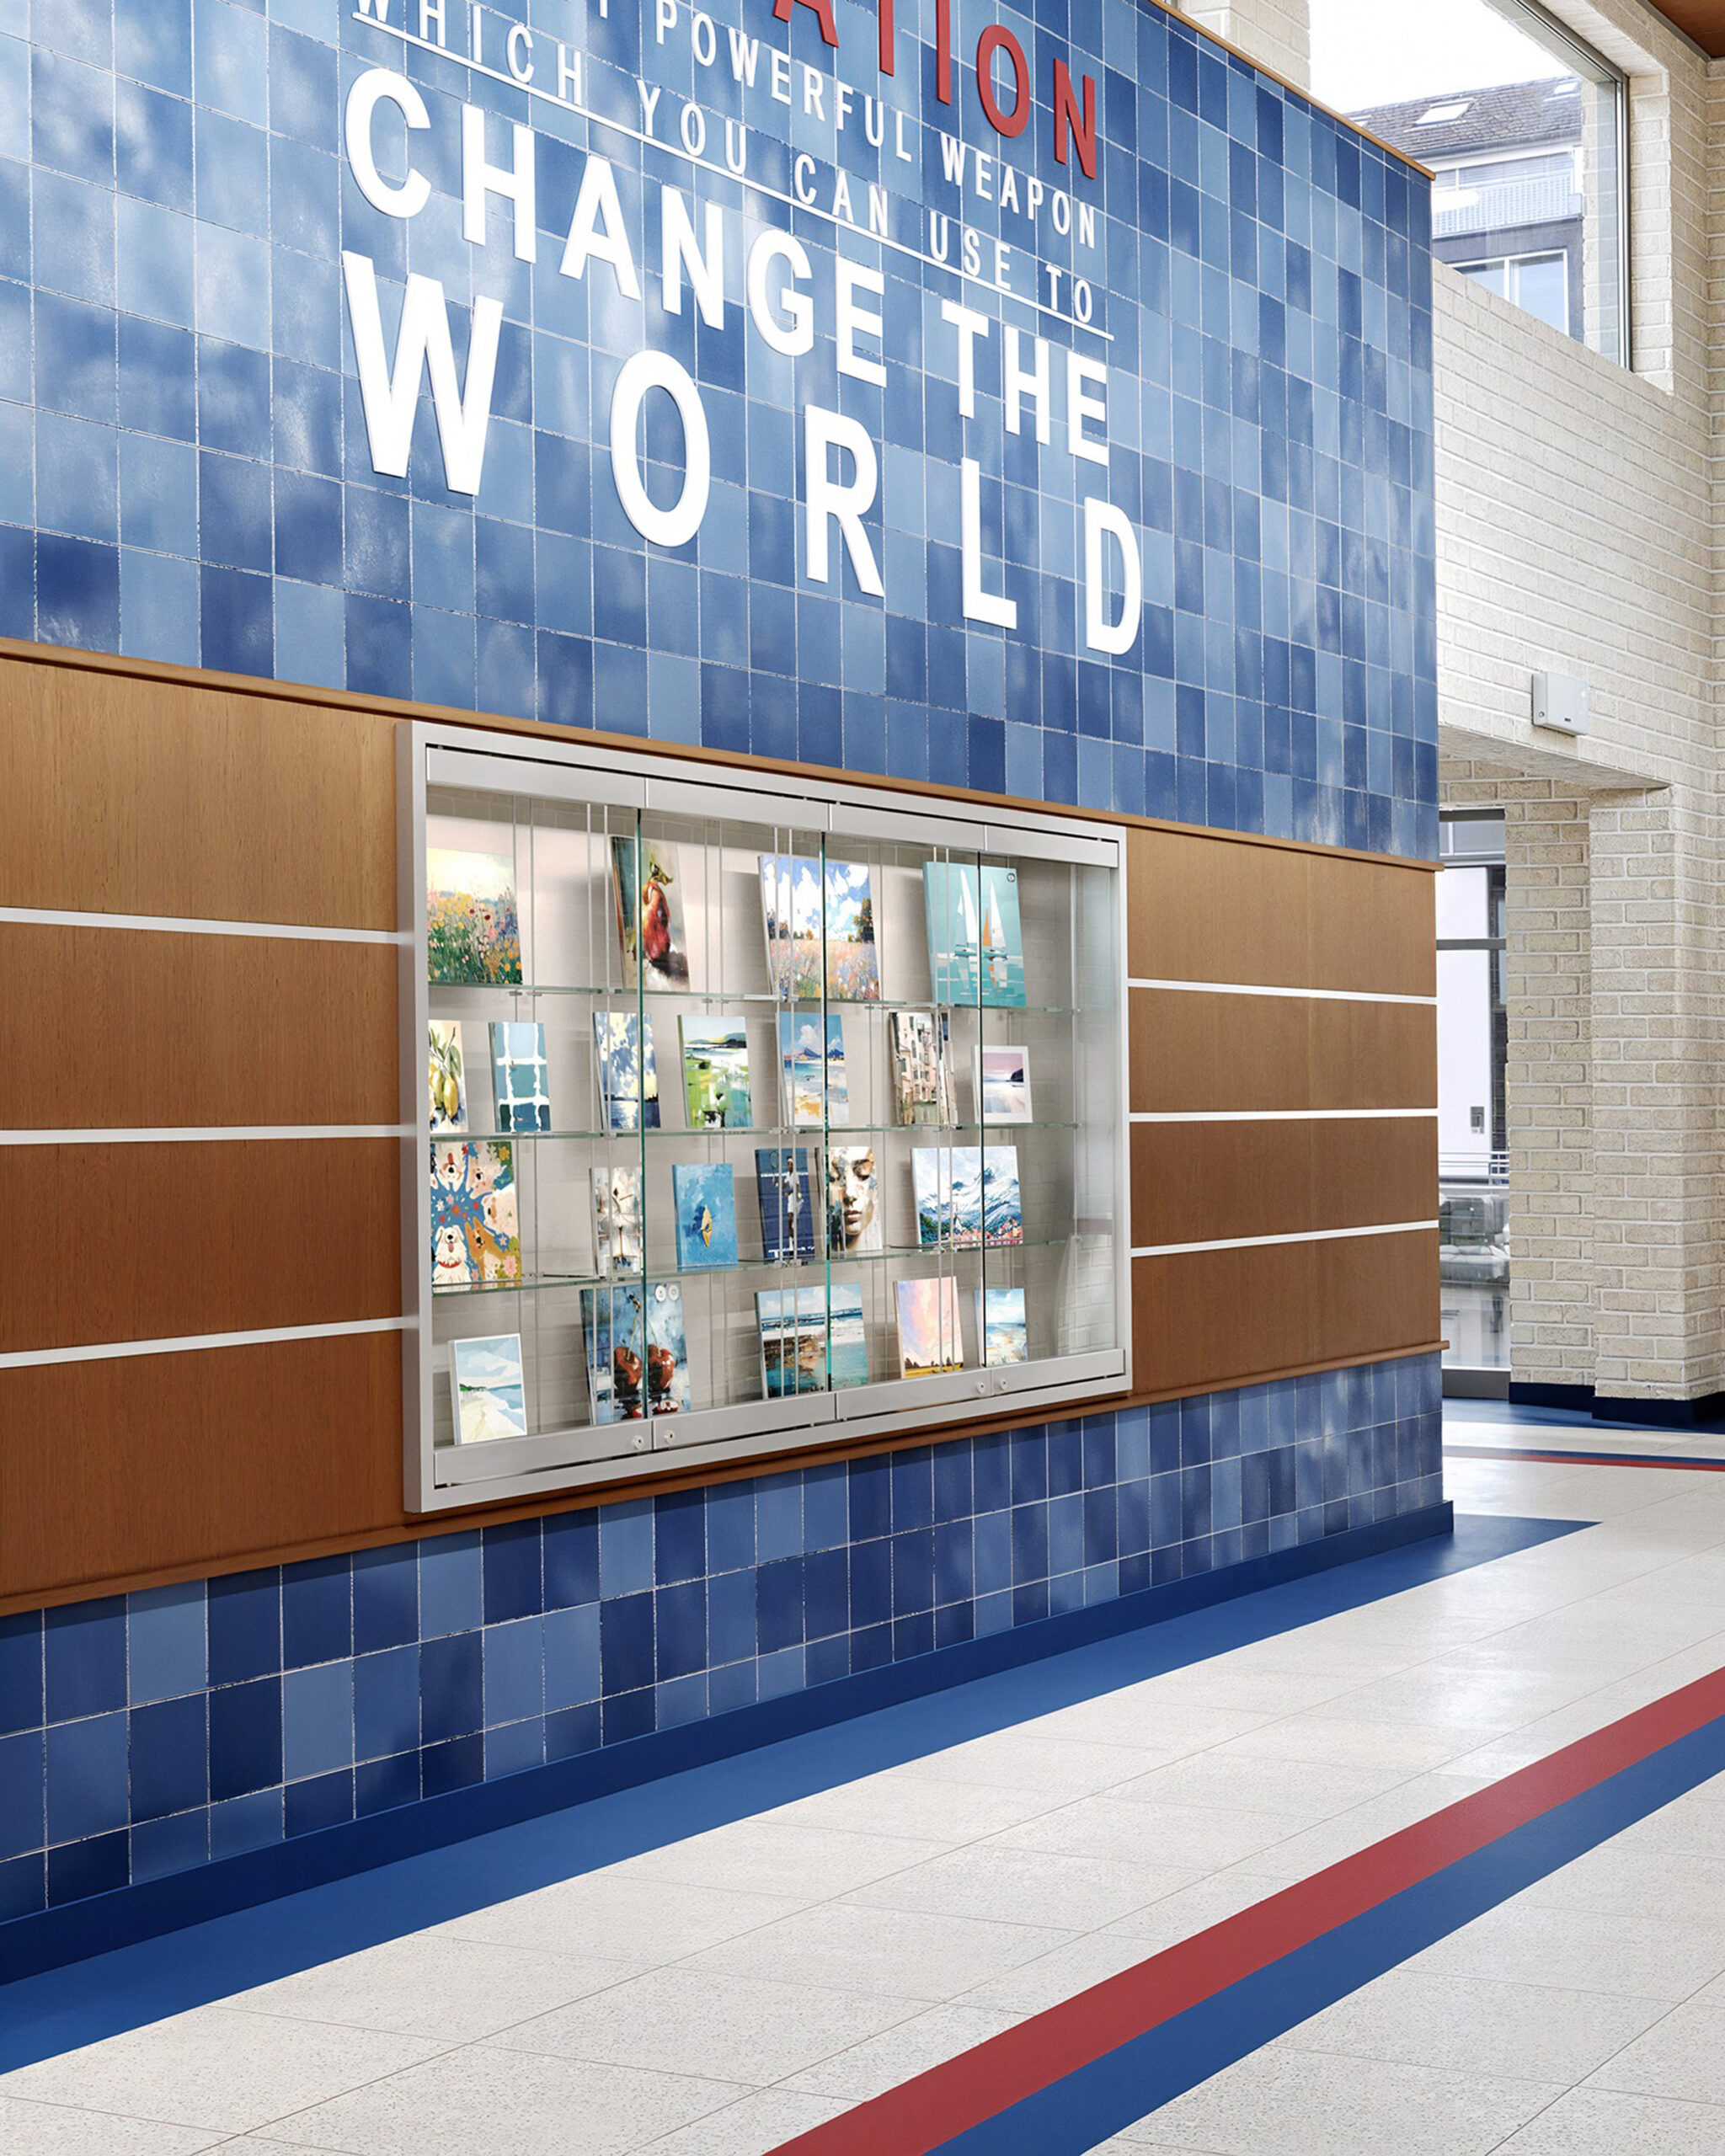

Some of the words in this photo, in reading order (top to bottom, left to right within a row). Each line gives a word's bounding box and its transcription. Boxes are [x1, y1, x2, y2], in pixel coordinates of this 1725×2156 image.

[344, 67, 887, 387] CHANGE
[942, 299, 1109, 467] THE
[636, 78, 747, 175] YOU
[794, 154, 889, 237] CAN
[930, 209, 1012, 291] USE
[1045, 264, 1093, 323] TO
[655, 0, 912, 163] POWERFUL
[941, 131, 1094, 248] WEAPON
[340, 249, 1142, 654] WORLD
